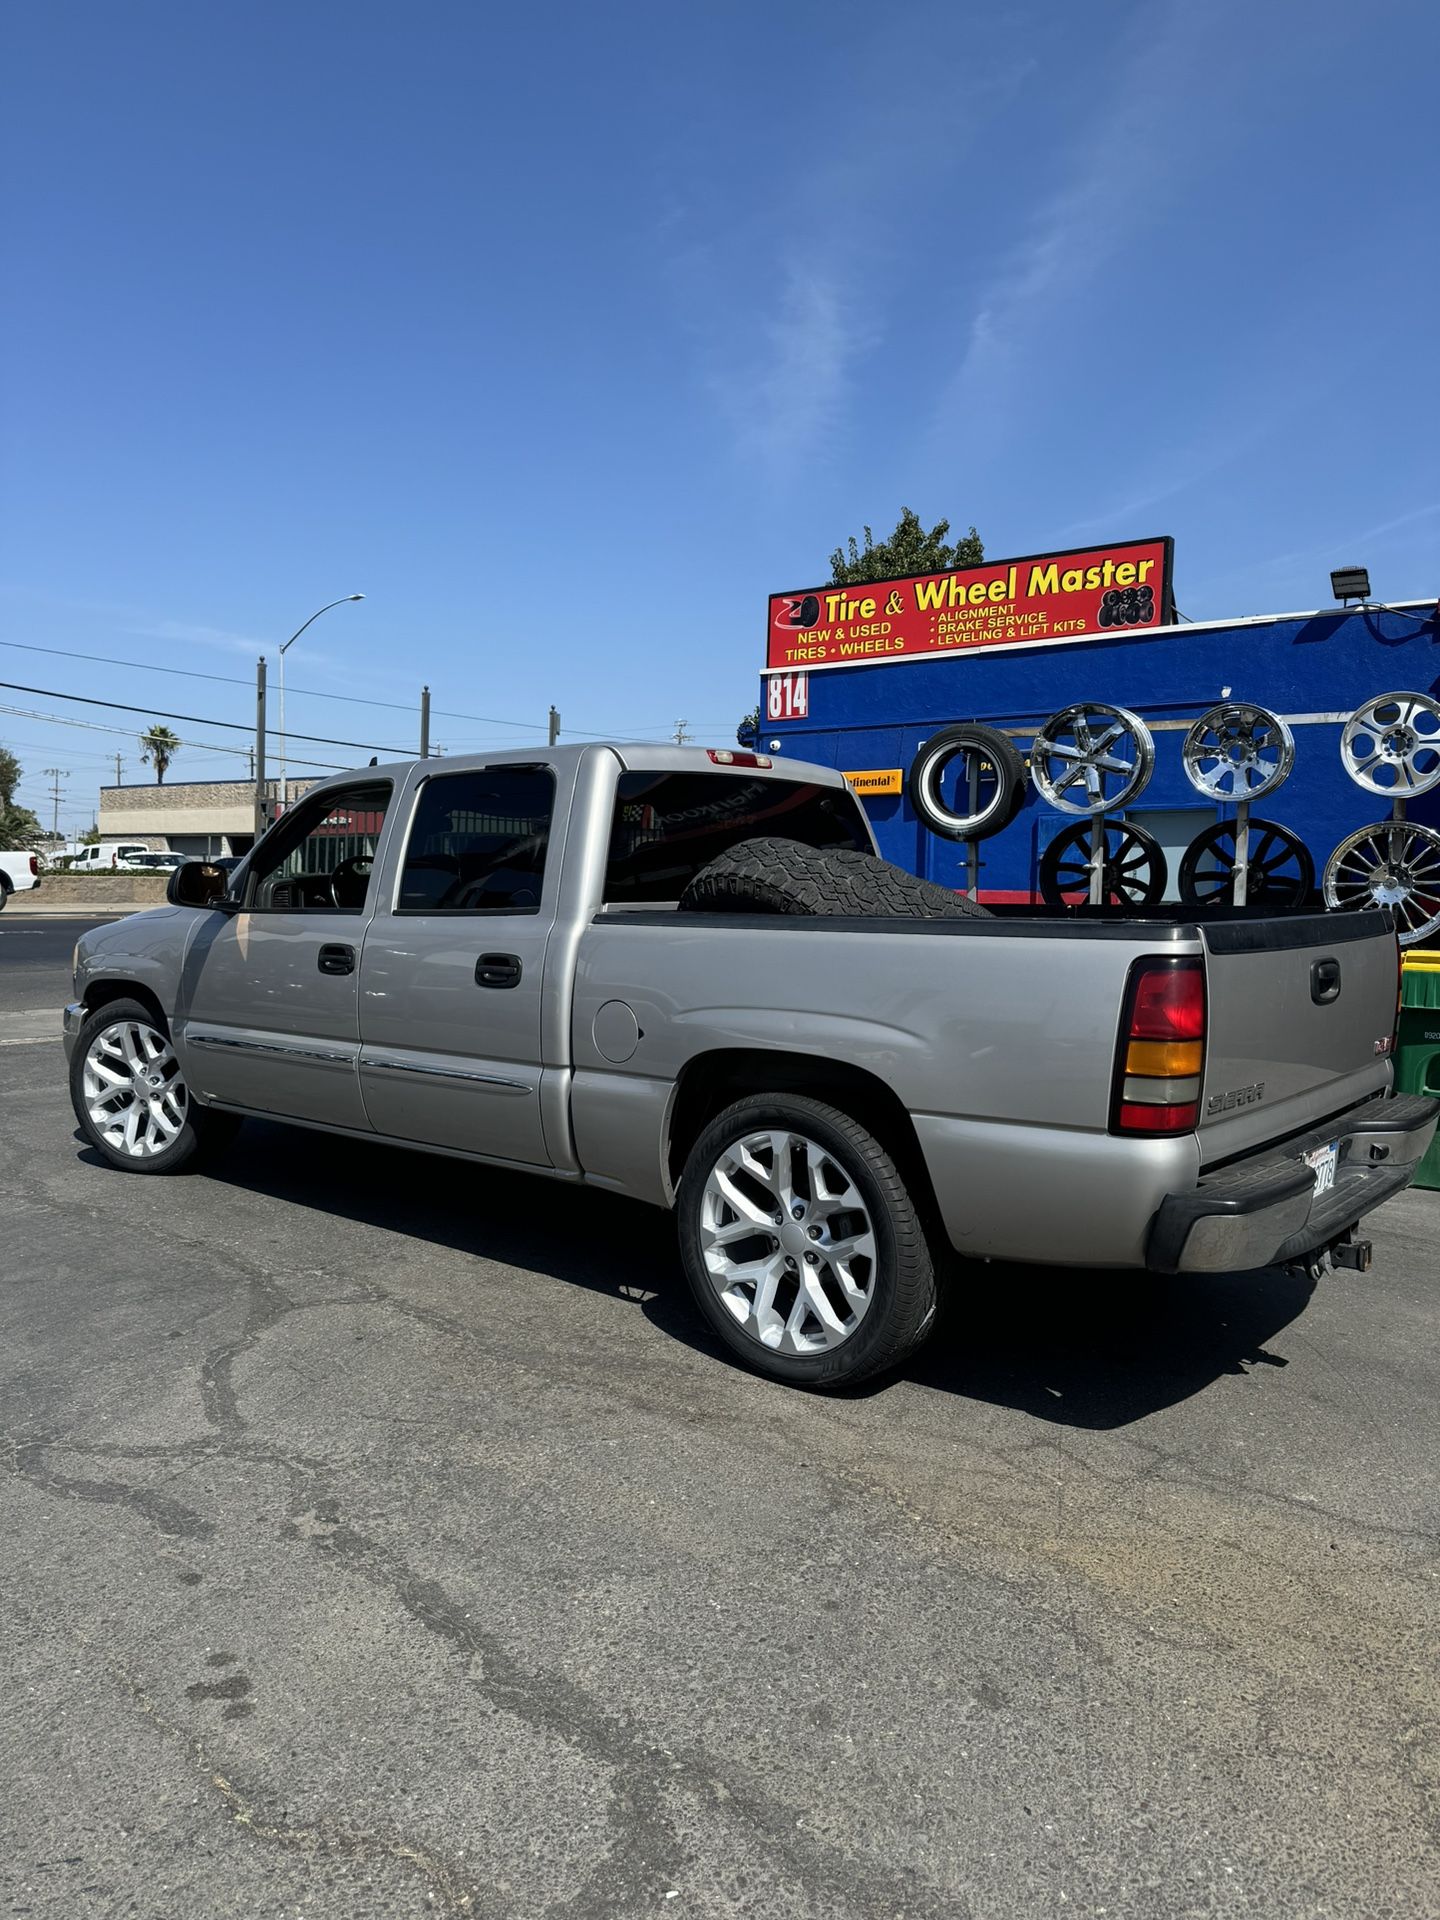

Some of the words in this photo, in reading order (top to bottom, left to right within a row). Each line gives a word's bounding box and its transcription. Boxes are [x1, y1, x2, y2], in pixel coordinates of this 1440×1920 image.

[825, 592, 877, 623] Tire
[885, 590, 905, 616] &
[914, 566, 1017, 611] Wheel
[1027, 559, 1155, 598] Master
[938, 603, 1017, 623] ALIGNMENT
[938, 619, 984, 634] BRAKE
[987, 611, 1047, 628] SERVICE
[797, 629, 831, 644] NEW
[835, 627, 845, 640] &
[850, 622, 892, 638] USED
[938, 628, 1002, 645] LEVELING
[1006, 627, 1016, 638] &
[1020, 623, 1049, 636] LIFT
[1053, 619, 1086, 633] KITS
[785, 646, 827, 661] TIRES
[840, 637, 905, 656] WHEELS
[770, 672, 806, 718] 814
